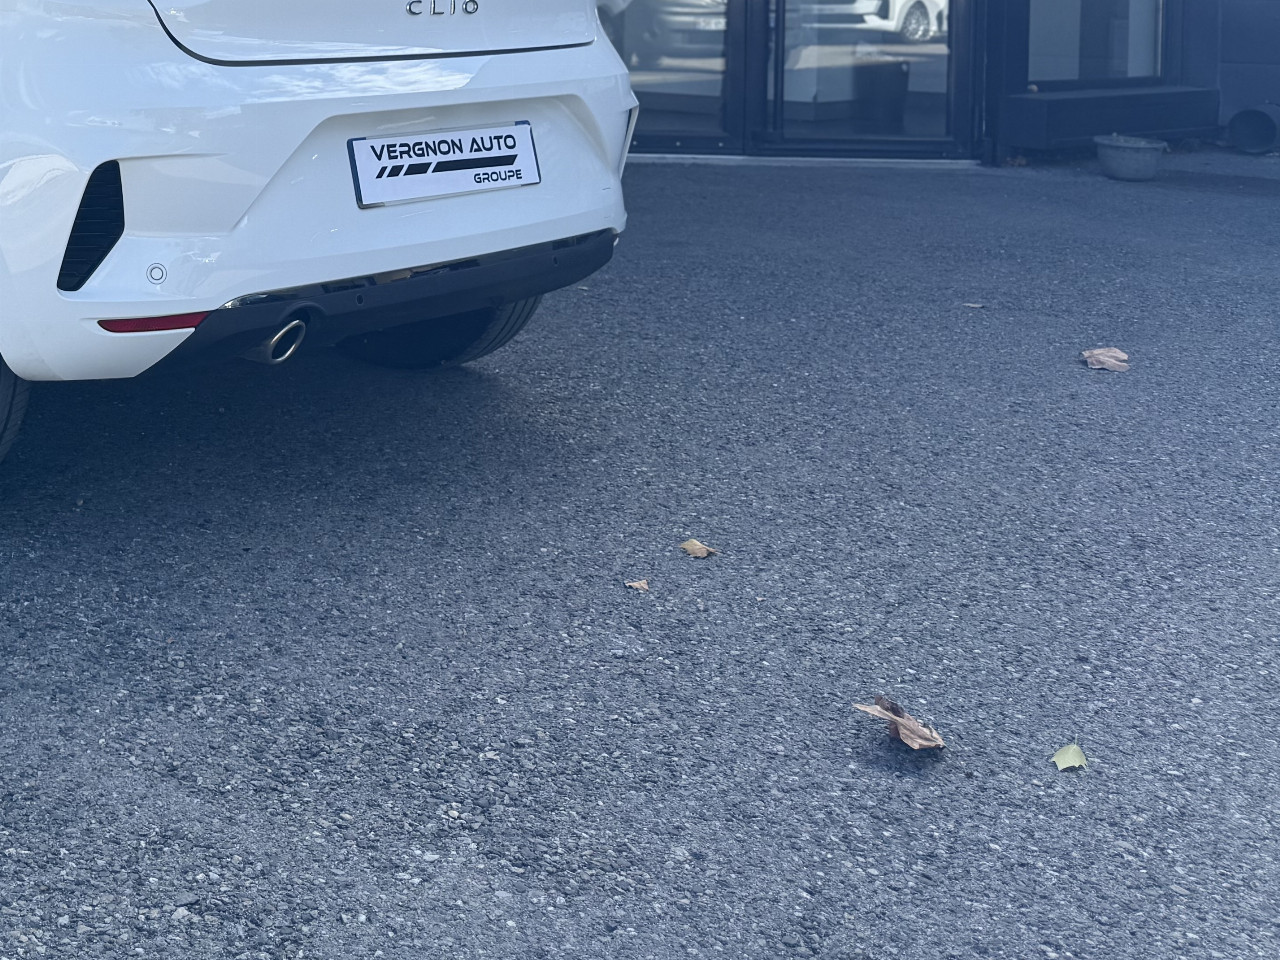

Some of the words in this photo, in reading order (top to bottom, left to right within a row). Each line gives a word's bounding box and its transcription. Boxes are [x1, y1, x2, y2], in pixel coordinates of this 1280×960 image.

[370, 138, 464, 162] VERGNON
[469, 134, 517, 153] AUTO
[473, 169, 523, 184] GROUPE
